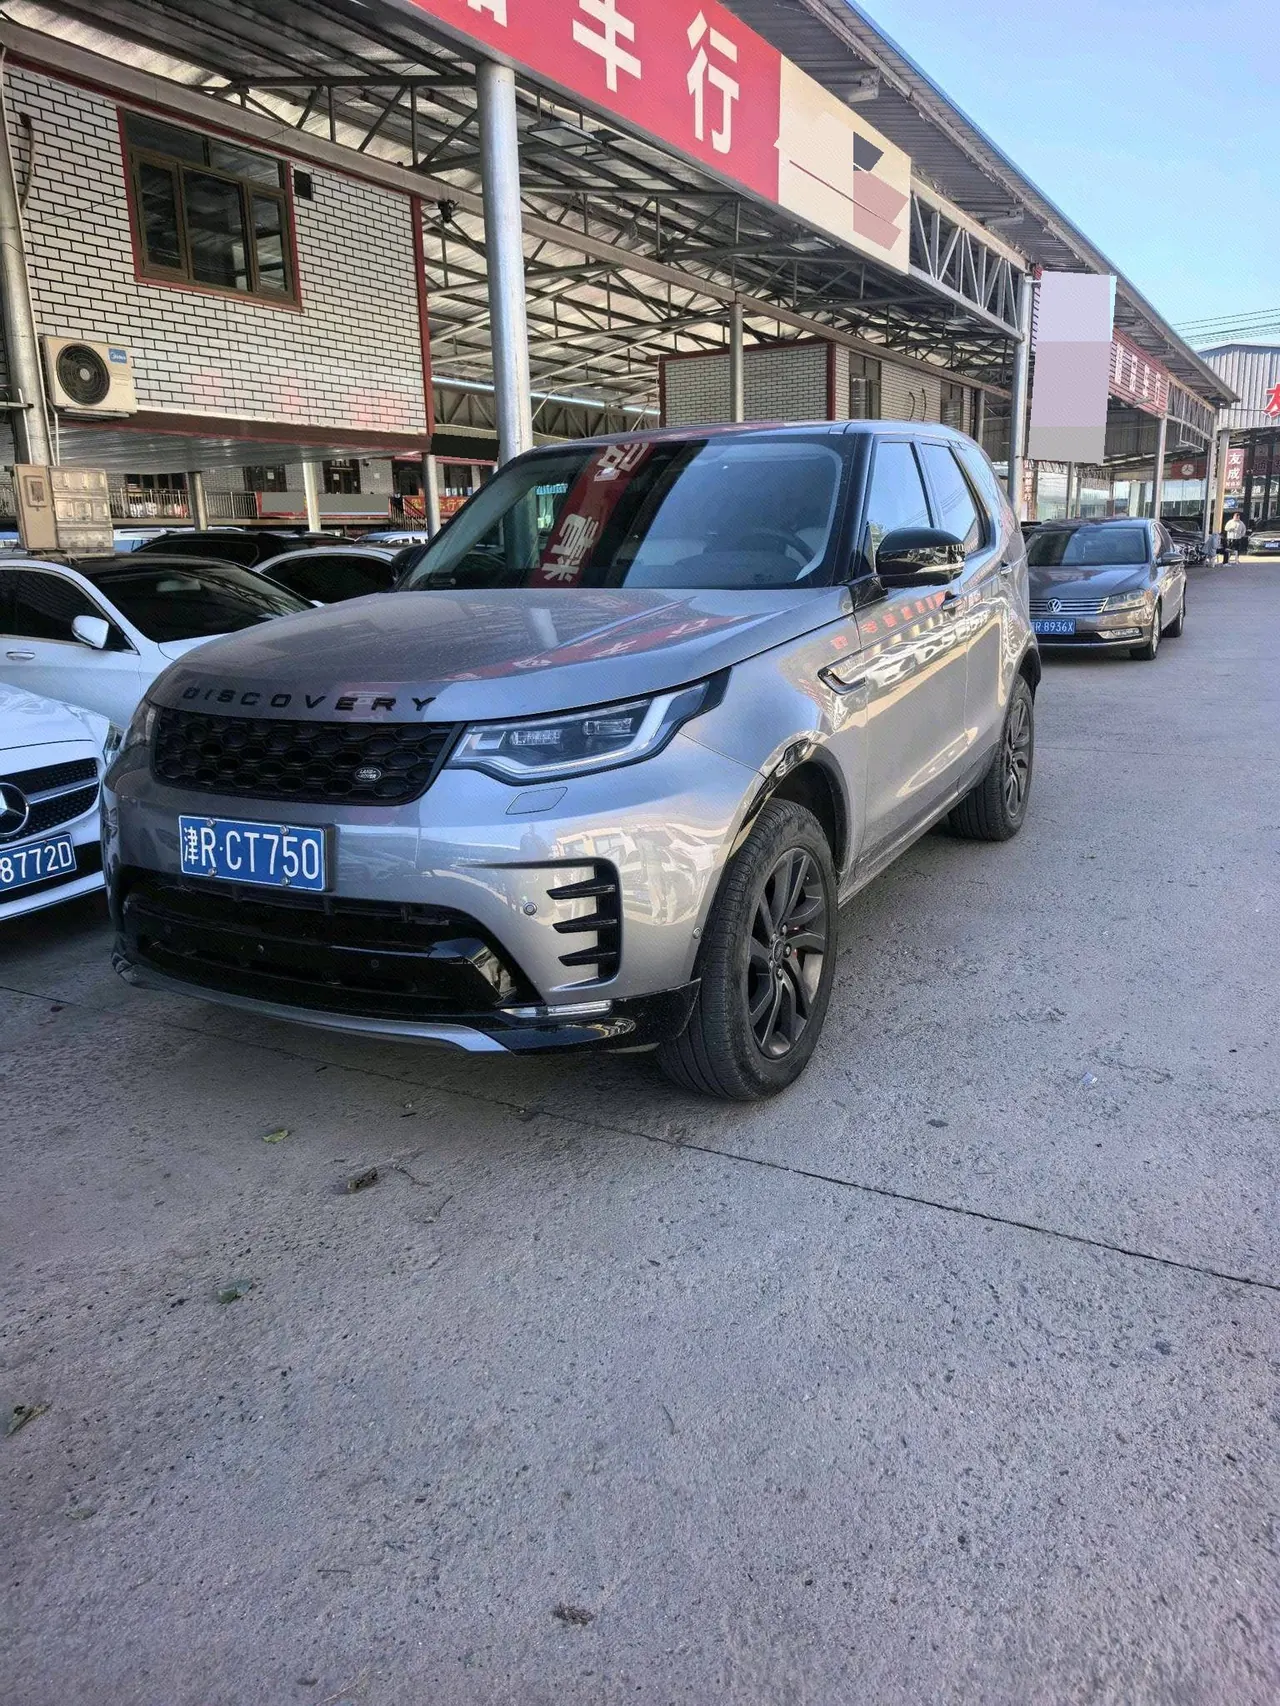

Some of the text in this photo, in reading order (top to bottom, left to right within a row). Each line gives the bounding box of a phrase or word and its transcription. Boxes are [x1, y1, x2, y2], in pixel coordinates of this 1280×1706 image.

[467, 0, 739, 154] 车行
[1228, 453, 1241, 480] 友成
[183, 686, 437, 711] DISCOVERY
